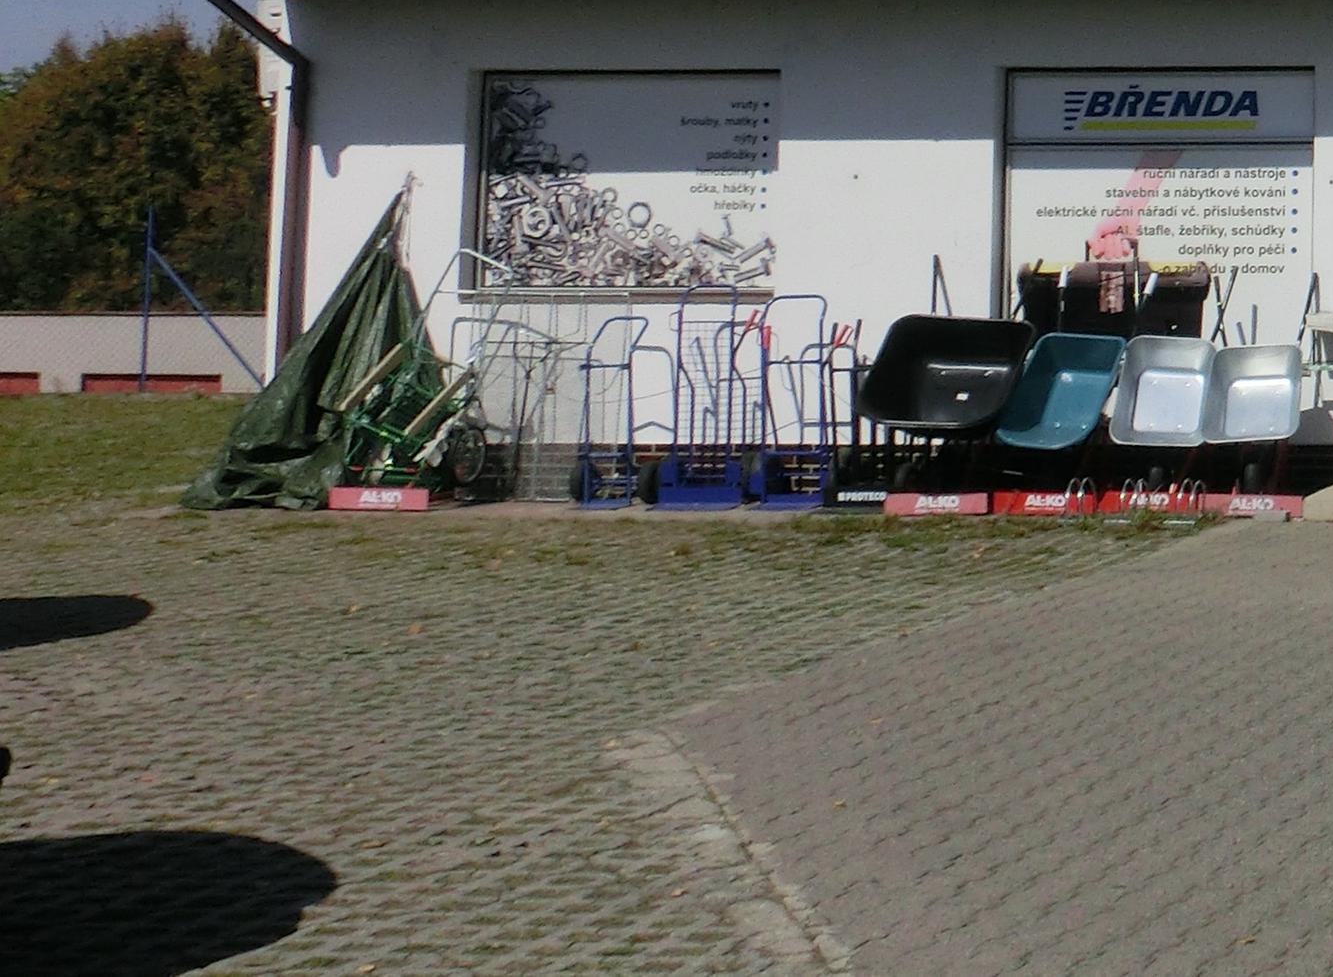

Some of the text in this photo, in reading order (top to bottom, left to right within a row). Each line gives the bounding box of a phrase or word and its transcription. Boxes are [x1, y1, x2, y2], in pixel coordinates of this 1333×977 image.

[1084, 84, 1259, 117] BŘENDA
[1234, 167, 1287, 181] nástroje
[1105, 186, 1159, 198] stavební
[1174, 186, 1240, 200] nábytkové
[1036, 205, 1097, 217] elektrické
[1233, 247, 1255, 258] pro
[1241, 263, 1285, 274] domov
[360, 490, 402, 503] AL-KO
[914, 495, 960, 508] AL-KO
[1024, 494, 1066, 507] AL-KO
[1229, 498, 1273, 511] AL-KO
